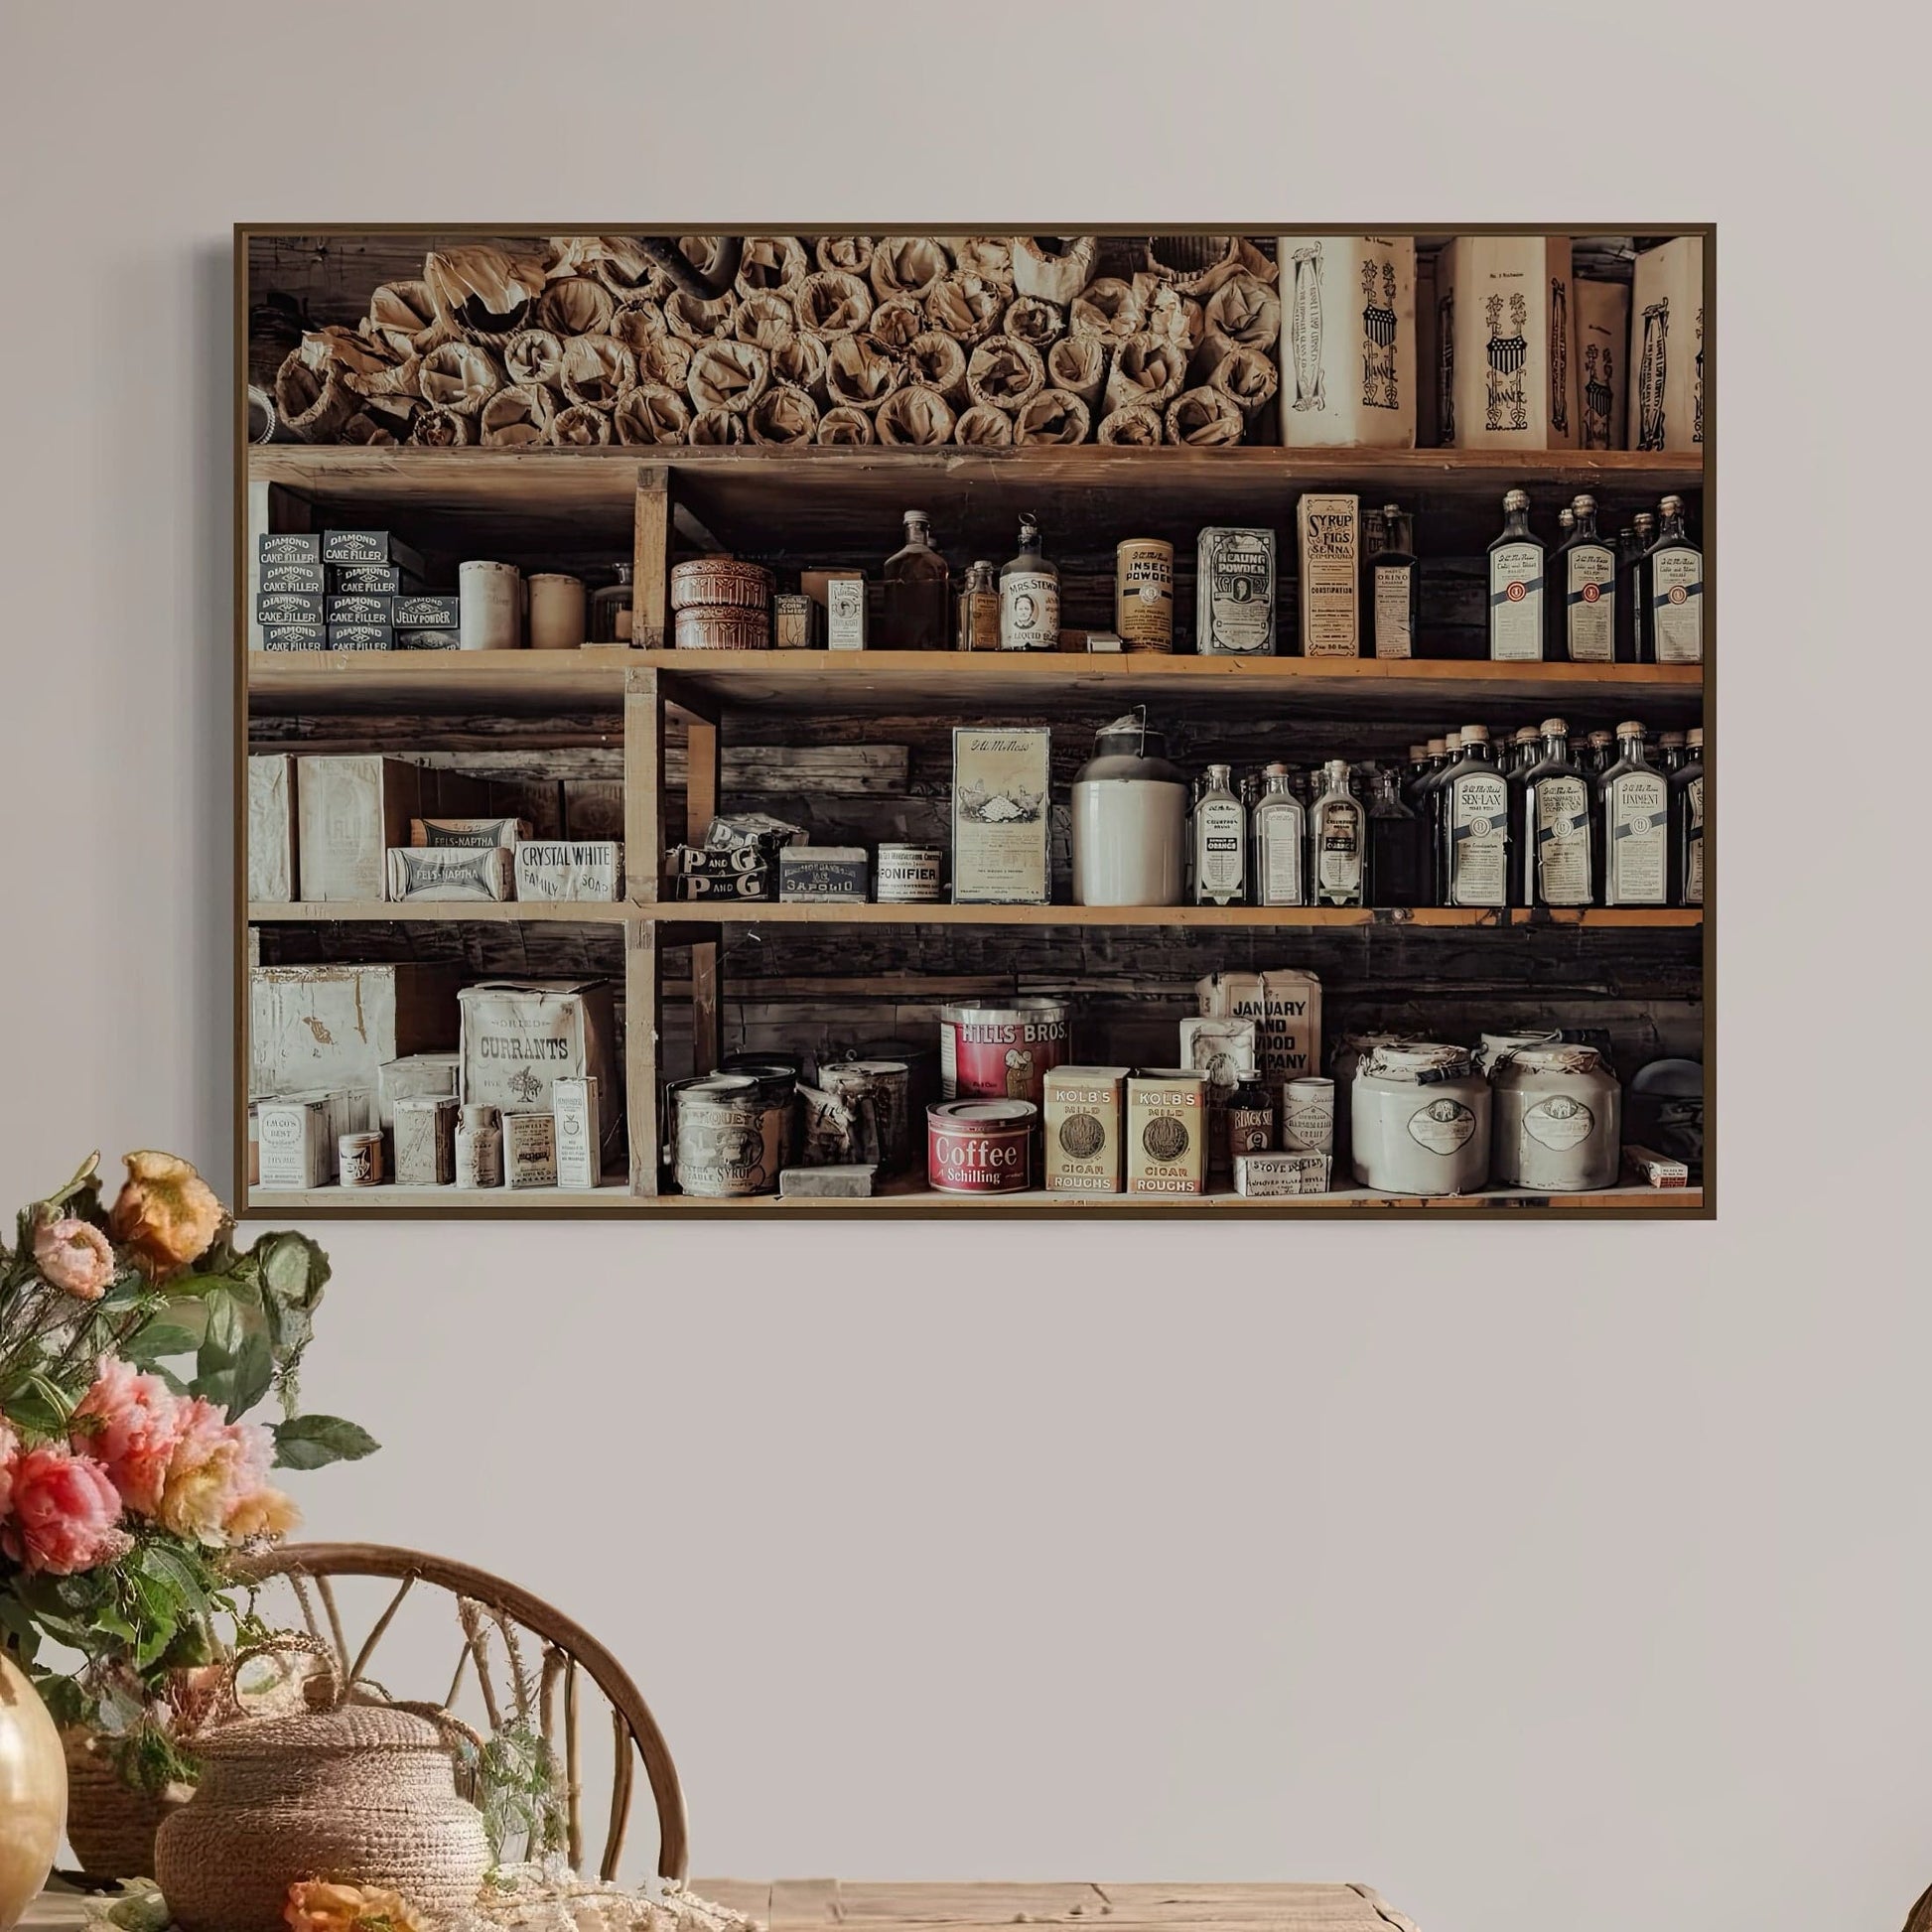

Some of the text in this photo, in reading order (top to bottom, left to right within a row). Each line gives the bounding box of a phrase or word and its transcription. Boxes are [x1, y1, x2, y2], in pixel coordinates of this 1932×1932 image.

[1310, 514, 1352, 538] SYRUP
[264, 536, 310, 550] DIAMOND
[331, 533, 377, 546] DIAMOND
[1323, 533, 1350, 545] FIGS
[261, 554, 315, 563] CAKE FILLER
[326, 550, 382, 560] CAKE FILLER
[1218, 554, 1266, 564] HEALING
[267, 566, 314, 578] DIAMOND
[345, 567, 391, 579] DIAMOND
[1129, 562, 1171, 576] INSECT
[1218, 563, 1266, 575] POWDER
[263, 582, 320, 592] CAKE FILLER
[342, 583, 396, 593] CAKE FILLER
[262, 597, 311, 609] DIAMOND
[334, 597, 381, 609] DIAMOND
[403, 597, 443, 607] DIAMOND
[258, 612, 316, 622] CAKE FILLER
[330, 613, 386, 623] CAKE FILLER
[396, 611, 418, 623] JELLY
[270, 625, 317, 638] DIAMOND
[336, 625, 382, 638] DIAMOND
[1014, 631, 1041, 640] LIQUID
[266, 642, 289, 651] CAKE
[332, 642, 355, 651] CAKE
[434, 837, 494, 847] FELS-NAPTHA
[522, 846, 611, 867] CRYSTAL WHITE
[684, 846, 757, 874] P AND G
[416, 868, 479, 881] FELS-NAPTHA
[524, 869, 609, 897] FAMILY SOAP
[686, 873, 760, 899] P AND G
[786, 881, 853, 892] SAPOLIO
[1232, 1001, 1307, 1016] JANUARY
[1255, 1020, 1287, 1033] AND
[962, 1024, 1017, 1043] HILLS
[481, 1036, 569, 1060] CURRANTS
[1055, 1090, 1111, 1103] KOLB'S
[1140, 1092, 1195, 1106] KOLB'S
[1064, 1105, 1100, 1114] MILD
[1148, 1108, 1184, 1117] MILD
[936, 1136, 1018, 1167] Coffee
[1061, 1164, 1104, 1174] CIGAR
[1145, 1167, 1188, 1177] CIGAR
[1253, 1161, 1287, 1173] STOVE
[947, 1168, 1001, 1184] Schilling
[1054, 1176, 1111, 1189] ROUGHS
[1137, 1179, 1195, 1191] ROUGHS
